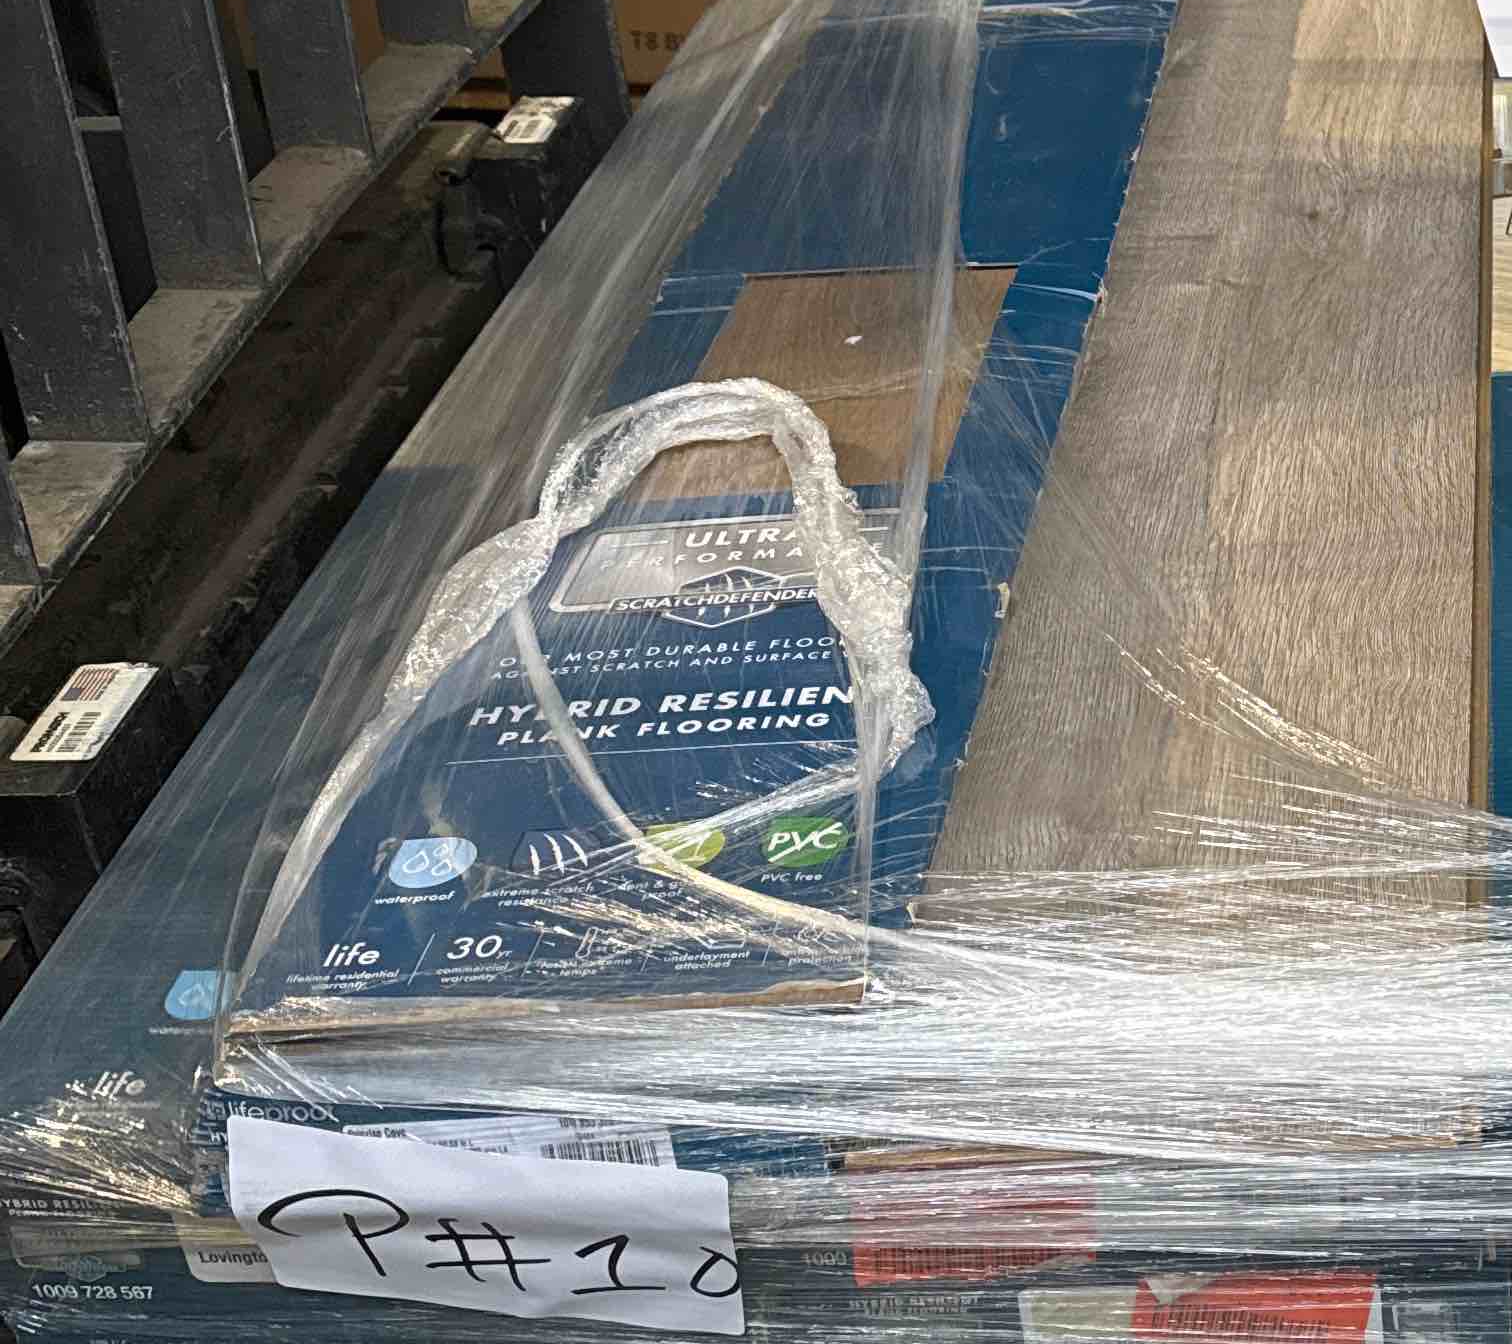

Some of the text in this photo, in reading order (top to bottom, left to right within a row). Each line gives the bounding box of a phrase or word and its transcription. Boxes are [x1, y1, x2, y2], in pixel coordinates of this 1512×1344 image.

[564, 640, 756, 663] MOST DURABLE
[589, 650, 833, 674] SCRATCH AND SURFACE
[658, 684, 854, 714] RESILIEN
[637, 712, 831, 738] FLOORING
[794, 870, 823, 882] free
[374, 891, 456, 906] waterproof
[322, 941, 381, 968] life
[31, 1284, 154, 1300] 1009 728 567
